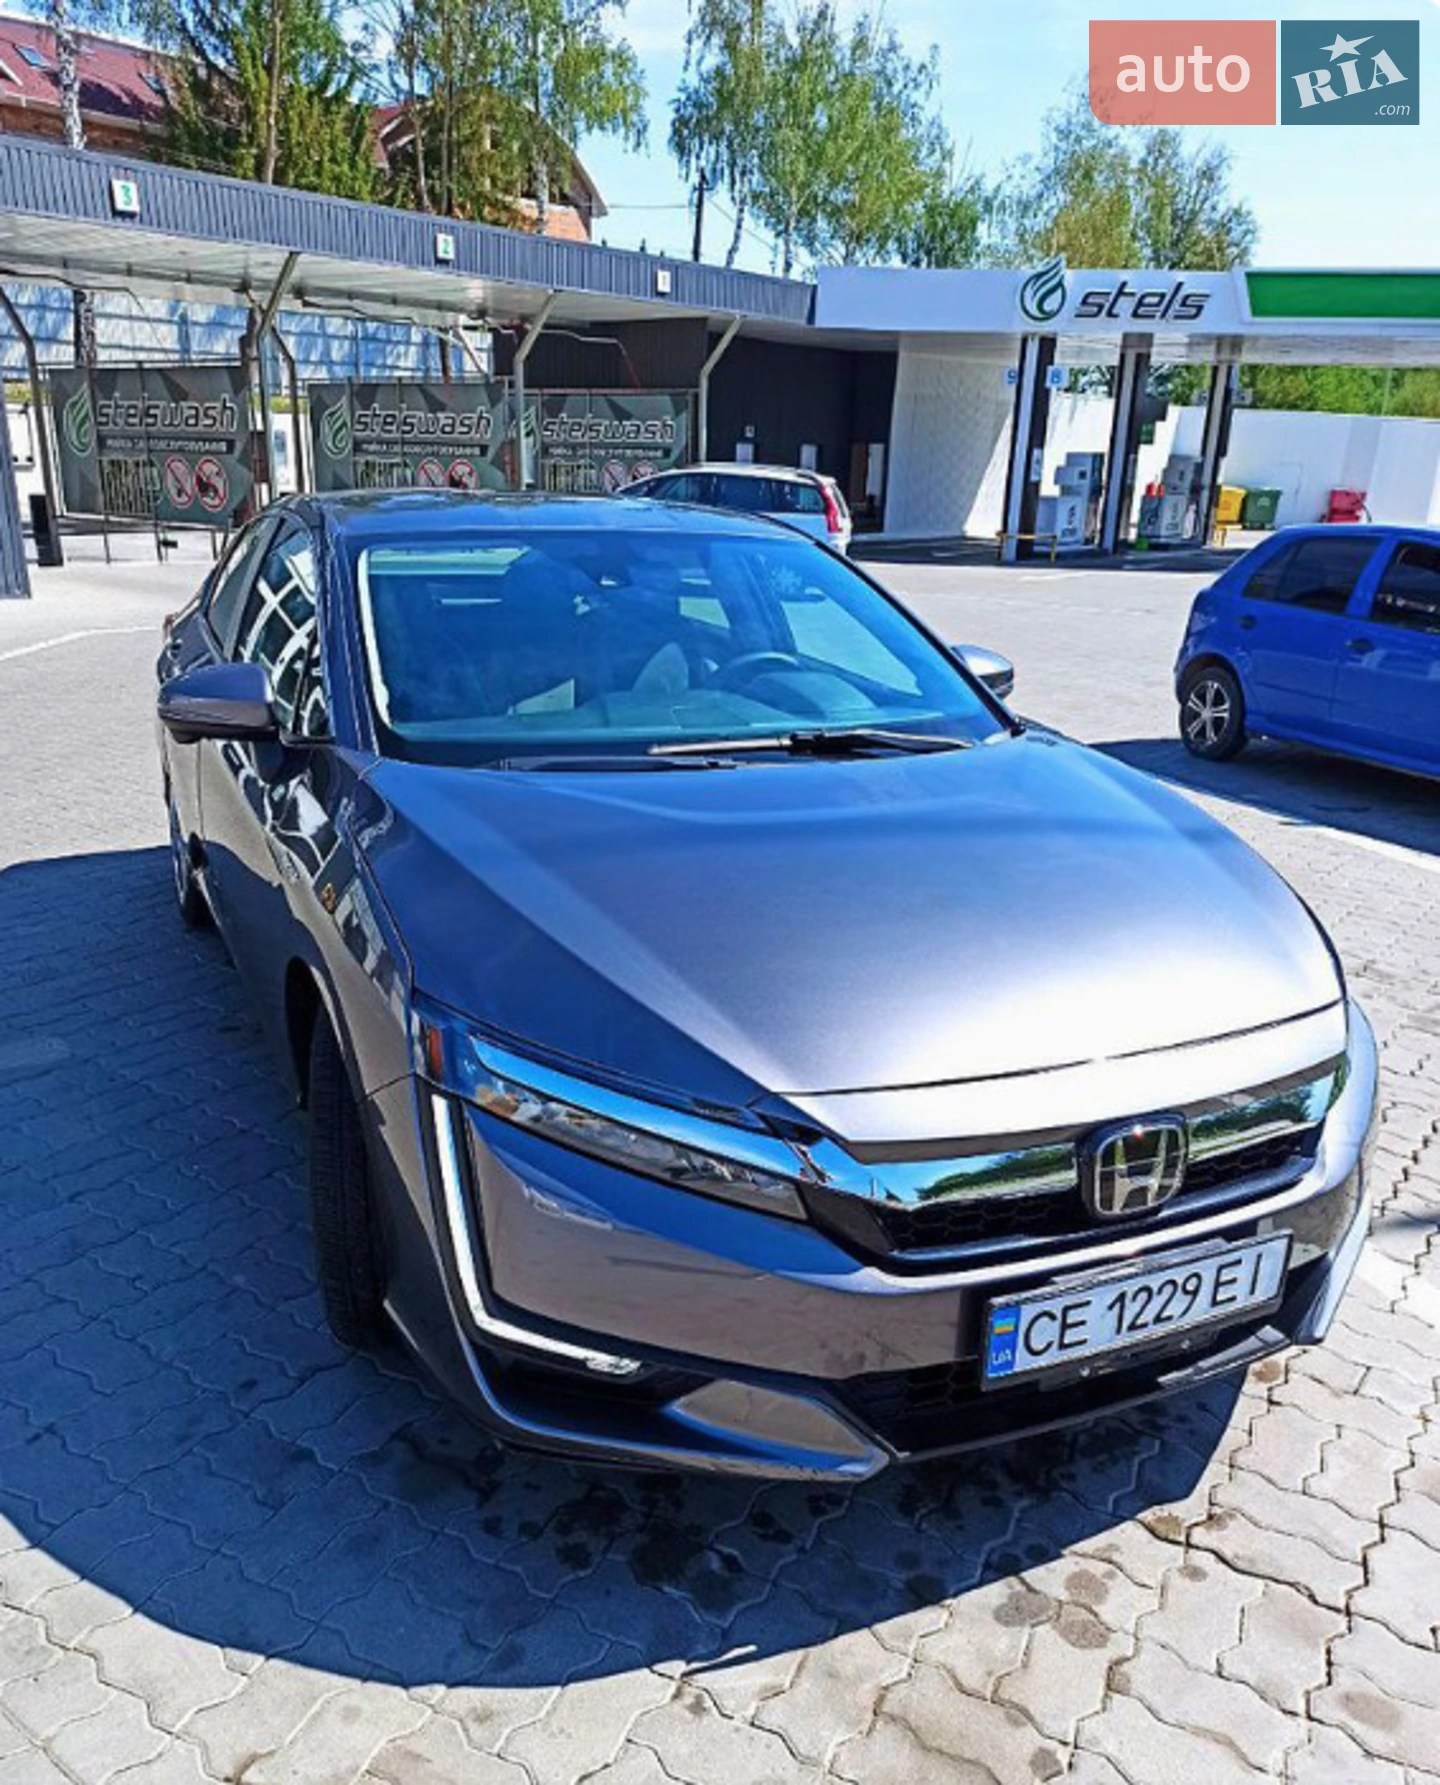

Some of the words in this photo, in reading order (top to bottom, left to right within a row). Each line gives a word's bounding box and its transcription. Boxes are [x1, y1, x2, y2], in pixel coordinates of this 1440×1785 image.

[121, 184, 132, 207] 3
[442, 236, 451, 255] 2
[1074, 281, 1212, 320] stels
[1024, 1300, 1092, 1356] CE
[1107, 1271, 1203, 1335] 1229
[1211, 1252, 1263, 1308] EI
[992, 1348, 1012, 1366] UA
